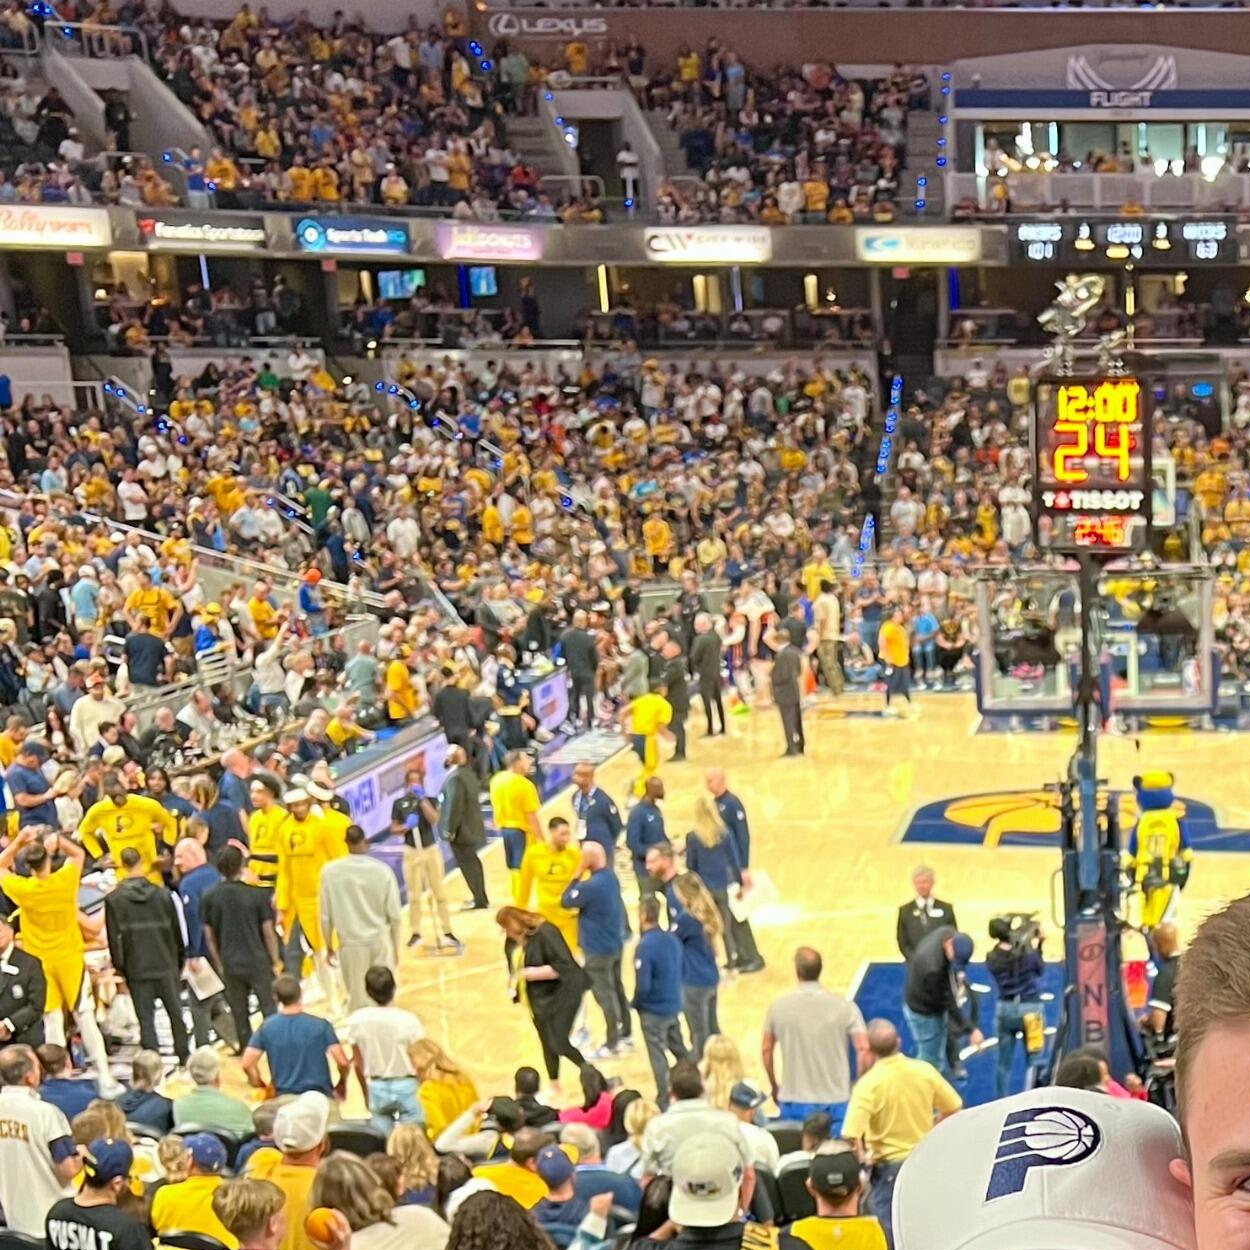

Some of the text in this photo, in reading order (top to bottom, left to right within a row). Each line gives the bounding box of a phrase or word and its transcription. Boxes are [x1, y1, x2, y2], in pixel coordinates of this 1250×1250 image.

[521, 18, 607, 32] LEXUS
[1089, 91, 1153, 107] FLIGHT
[1058, 381, 1139, 422] 12:00
[1054, 423, 1129, 482] 24
[1070, 490, 1144, 510] TISSOT
